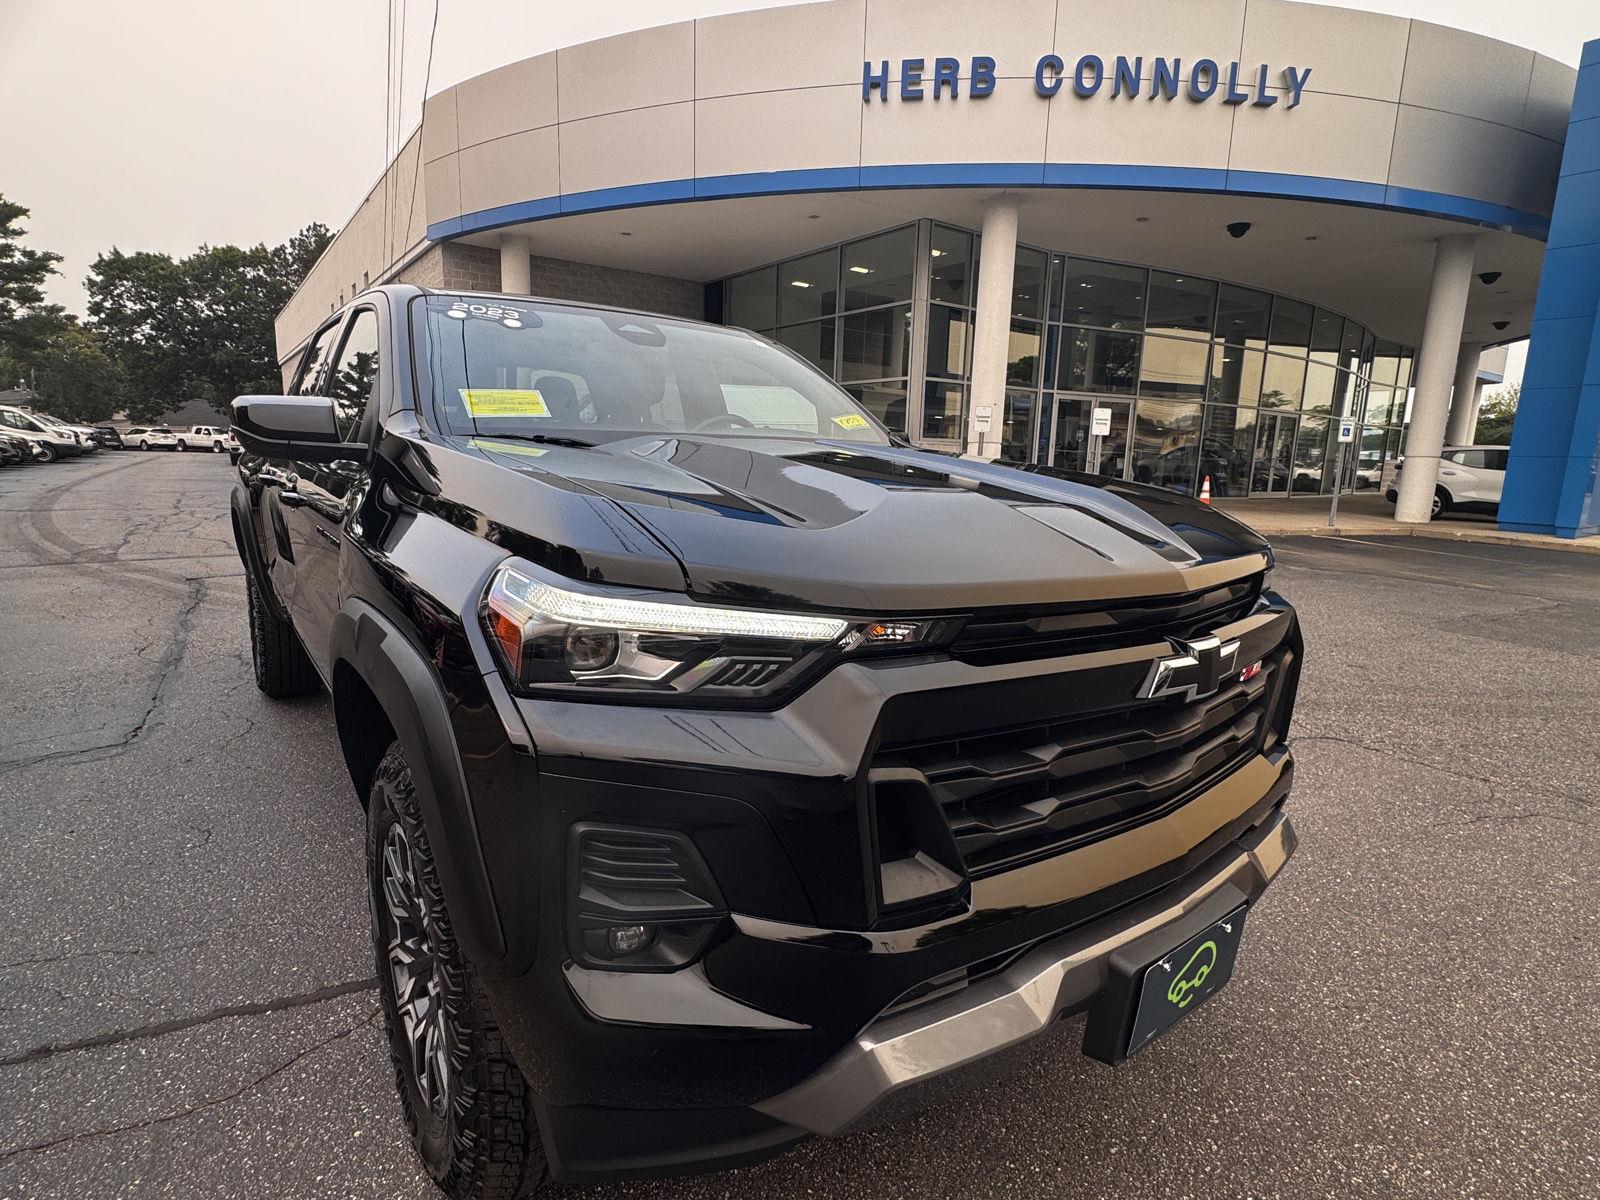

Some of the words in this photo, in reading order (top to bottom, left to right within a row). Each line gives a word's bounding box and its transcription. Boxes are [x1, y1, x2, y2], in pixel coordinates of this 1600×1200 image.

[862, 56, 997, 102] HERB
[1034, 54, 1313, 109] CONNOLLY
[452, 302, 520, 319] 2023
